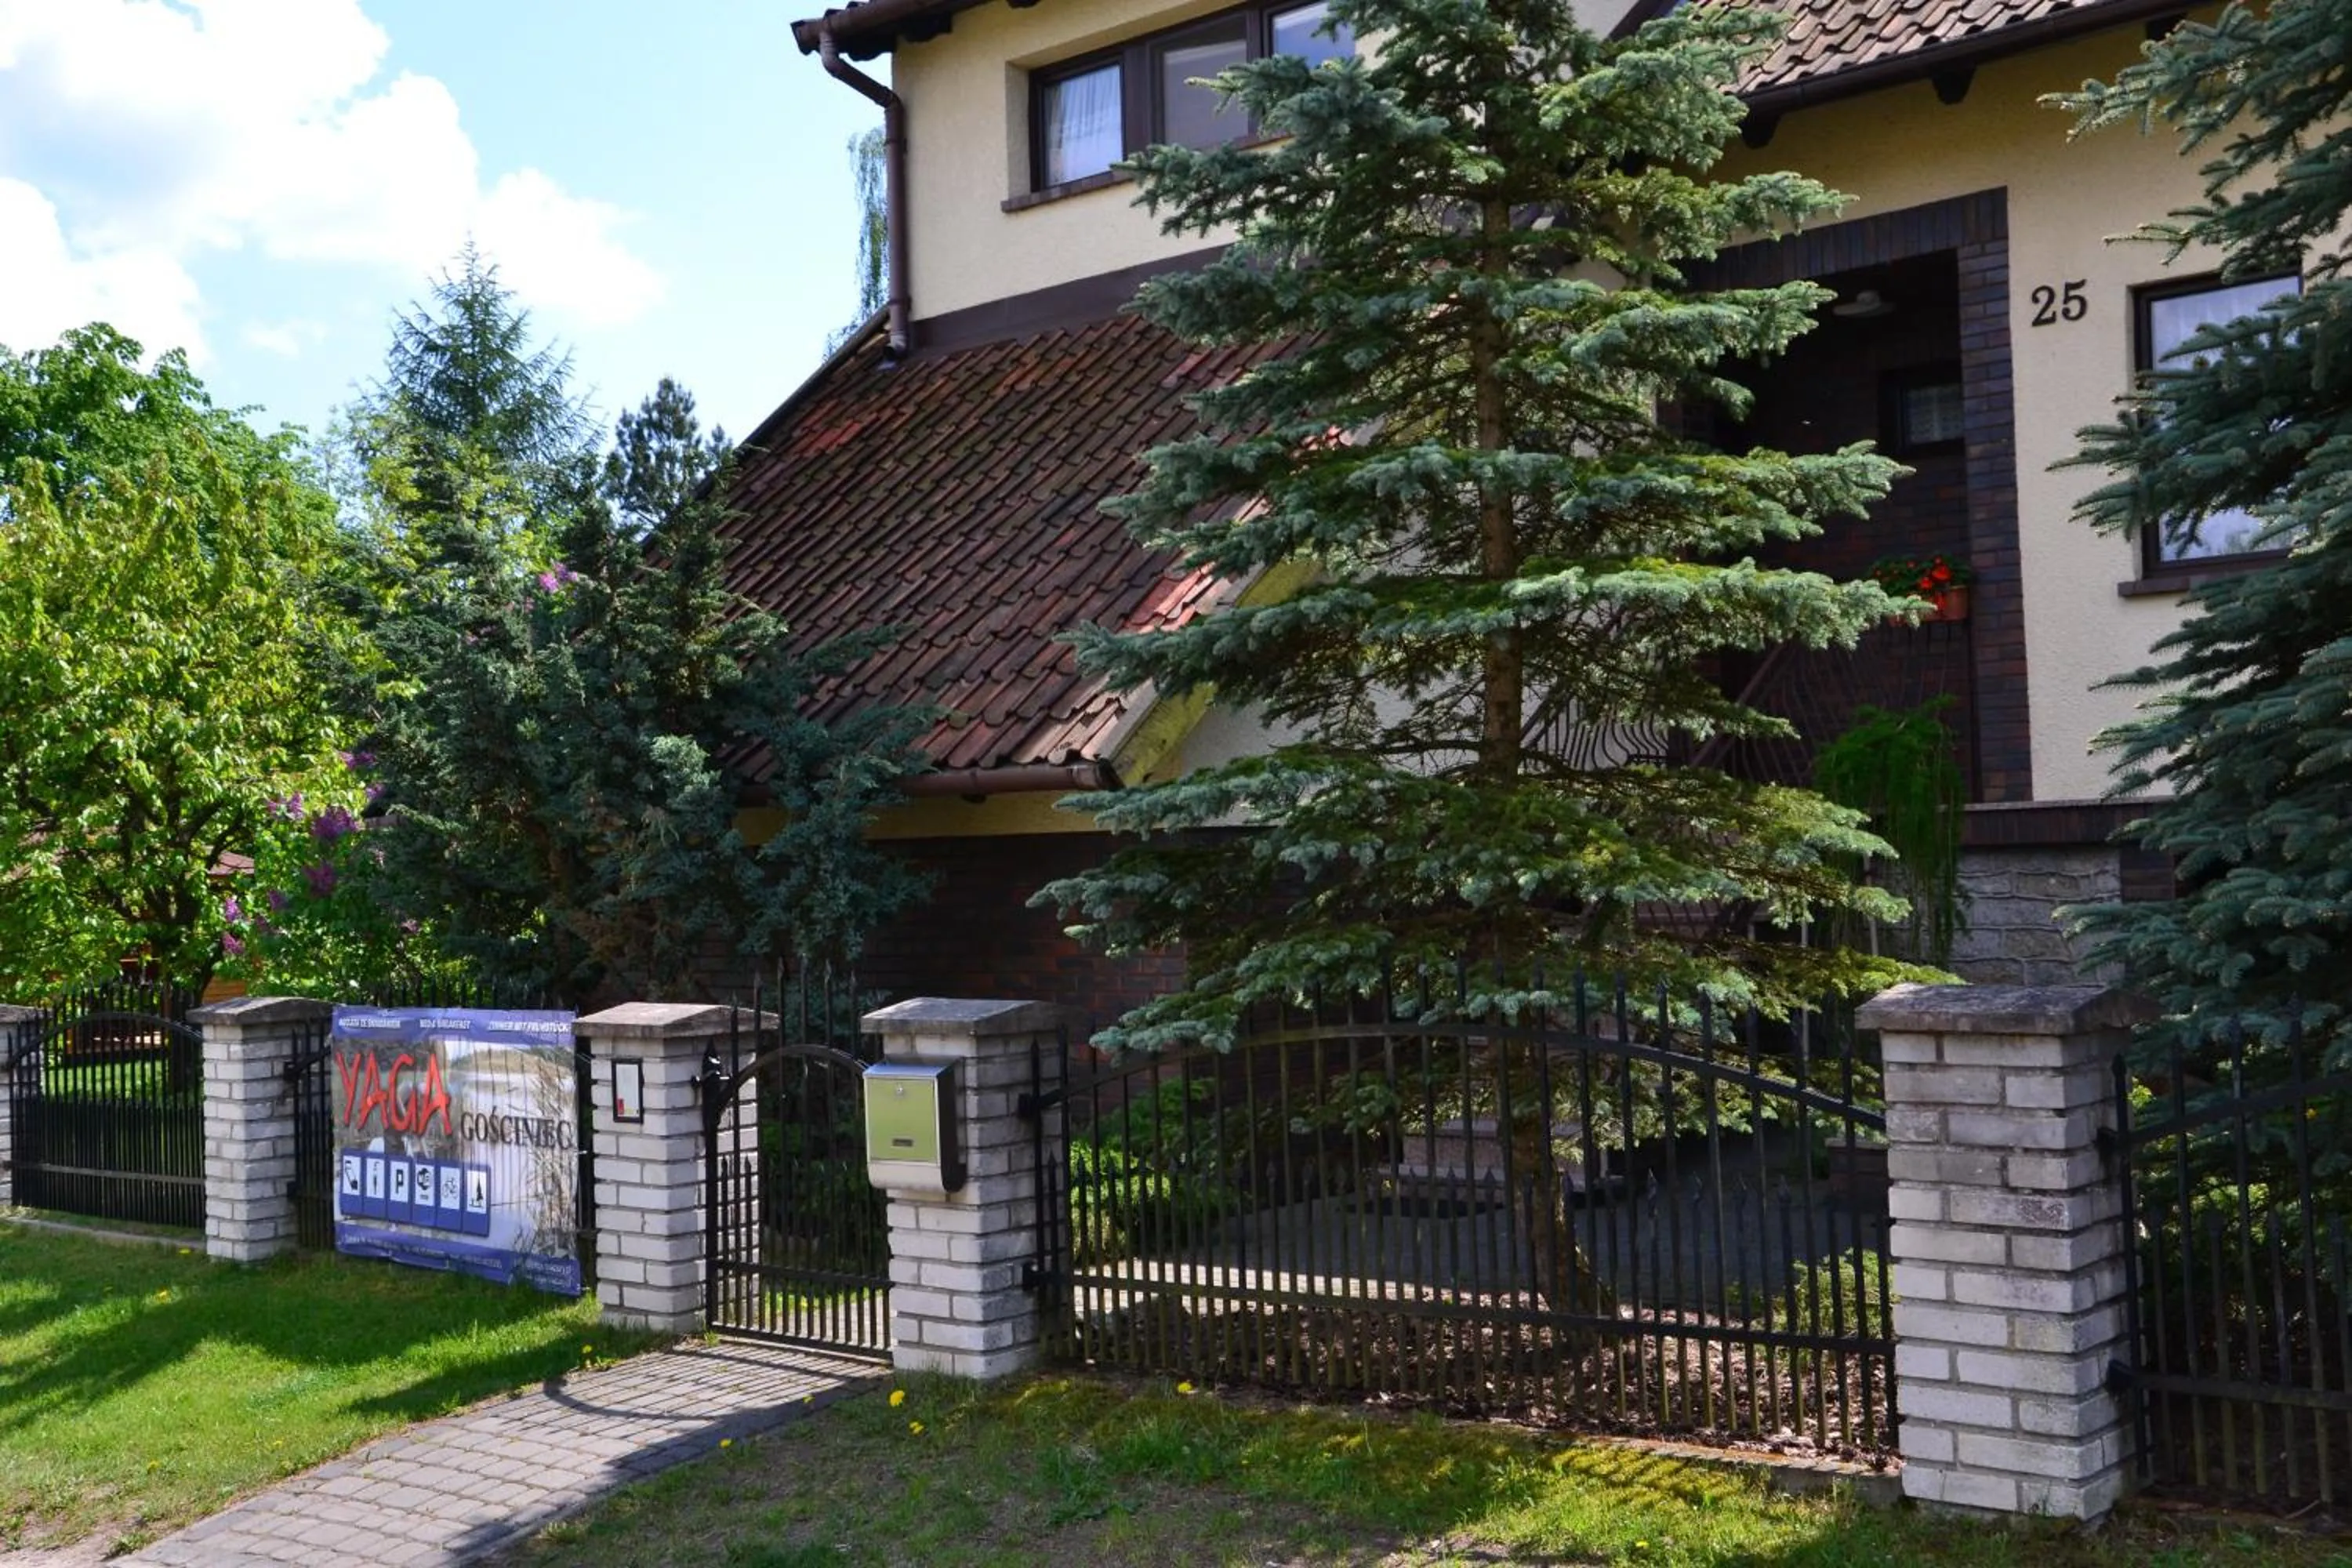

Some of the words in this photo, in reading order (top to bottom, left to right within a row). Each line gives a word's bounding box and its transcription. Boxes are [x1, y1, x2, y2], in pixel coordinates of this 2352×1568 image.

[2031, 278, 2088, 328] 25
[336, 1048, 452, 1136] YAGA
[460, 1106, 573, 1149] GOŚCINIEC
